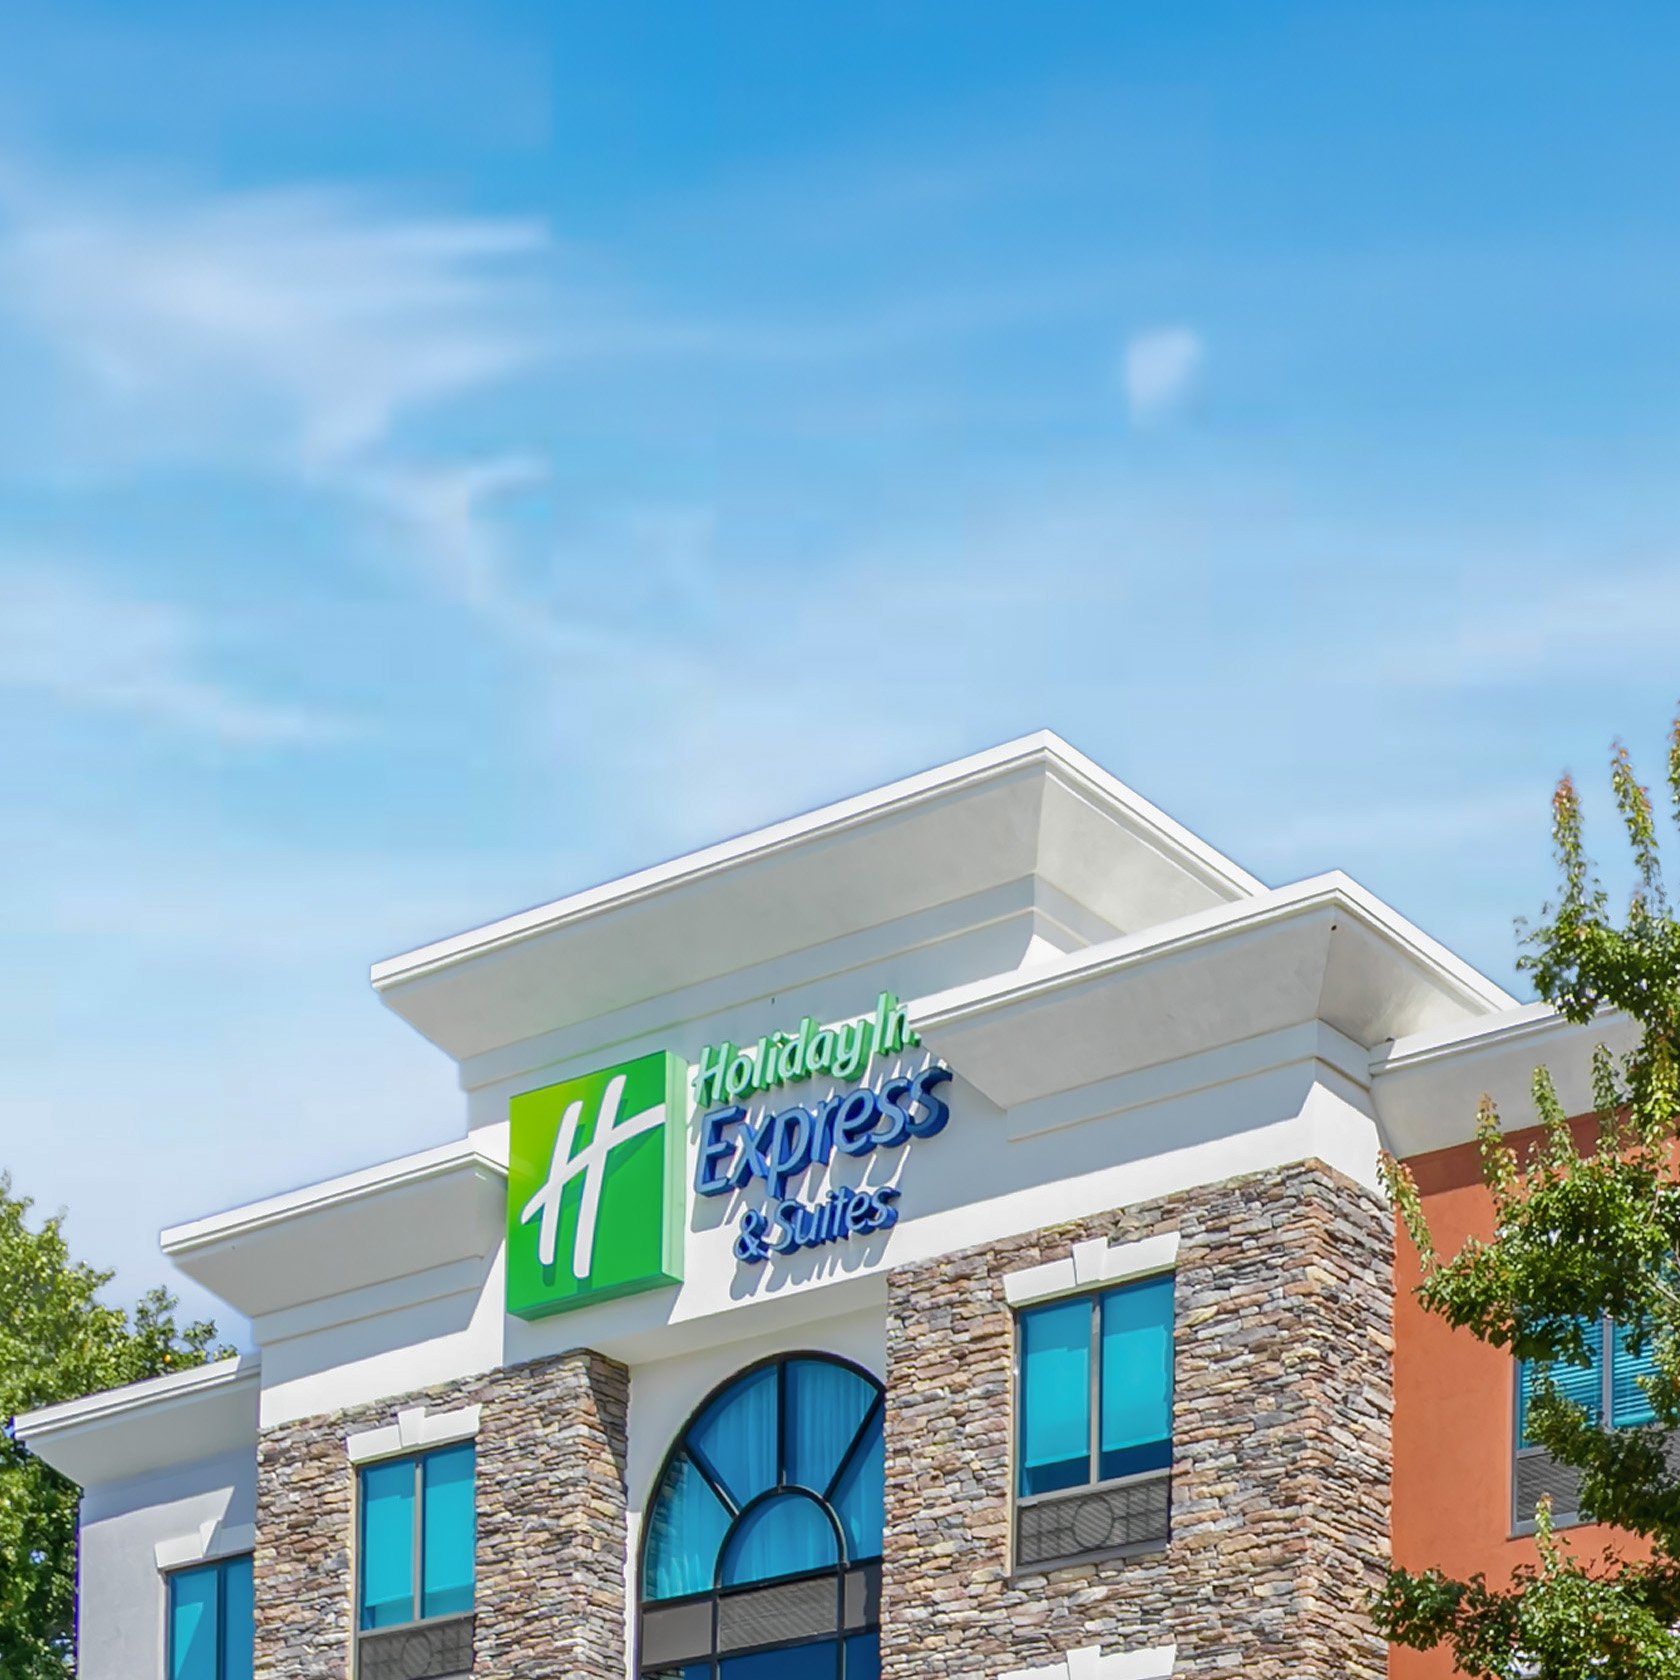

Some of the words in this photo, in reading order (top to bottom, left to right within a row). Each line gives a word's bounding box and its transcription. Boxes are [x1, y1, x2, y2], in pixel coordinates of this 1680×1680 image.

[692, 1015, 869, 1108] Holiday
[872, 990, 921, 1056] In
[694, 1066, 953, 1200] Express
[733, 1208, 770, 1264] &
[770, 1186, 901, 1255] Suites
